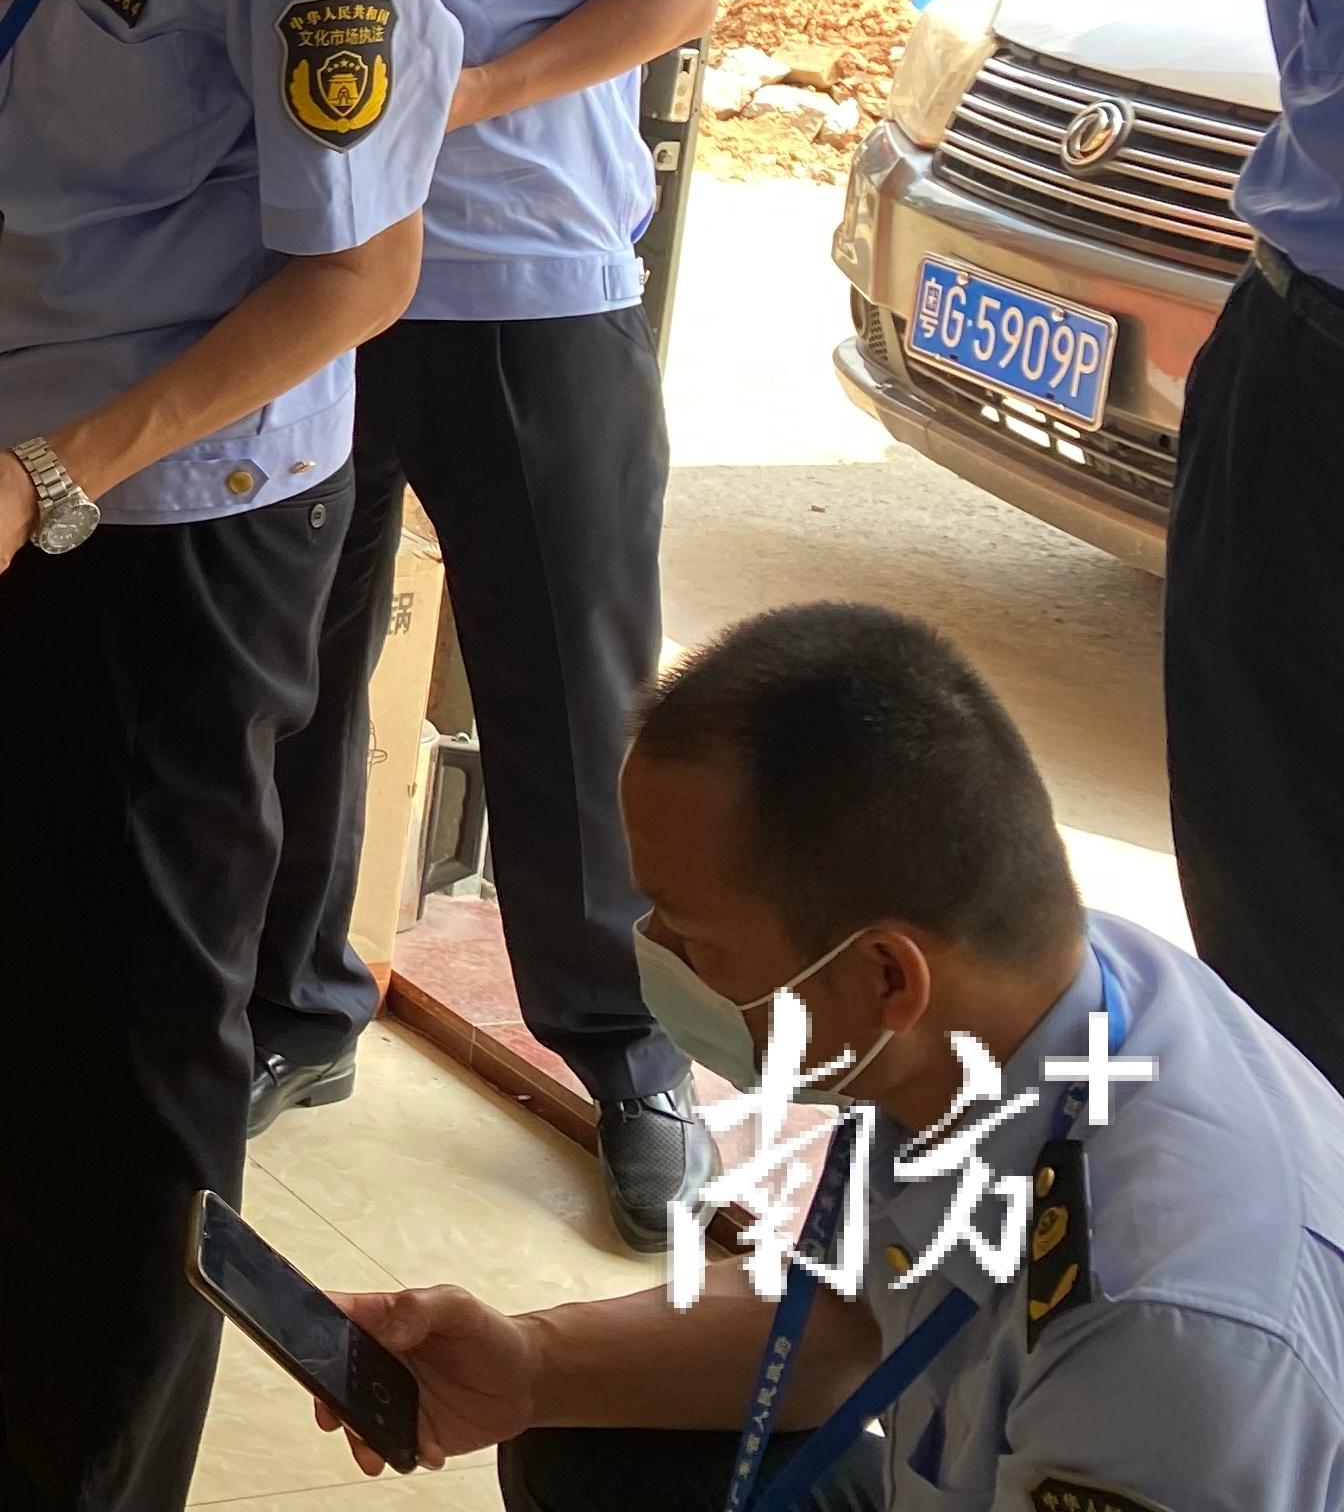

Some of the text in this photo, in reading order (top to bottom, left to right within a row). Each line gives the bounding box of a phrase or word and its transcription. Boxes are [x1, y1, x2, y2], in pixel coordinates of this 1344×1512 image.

[289, 4, 391, 31] 中华人民共和国
